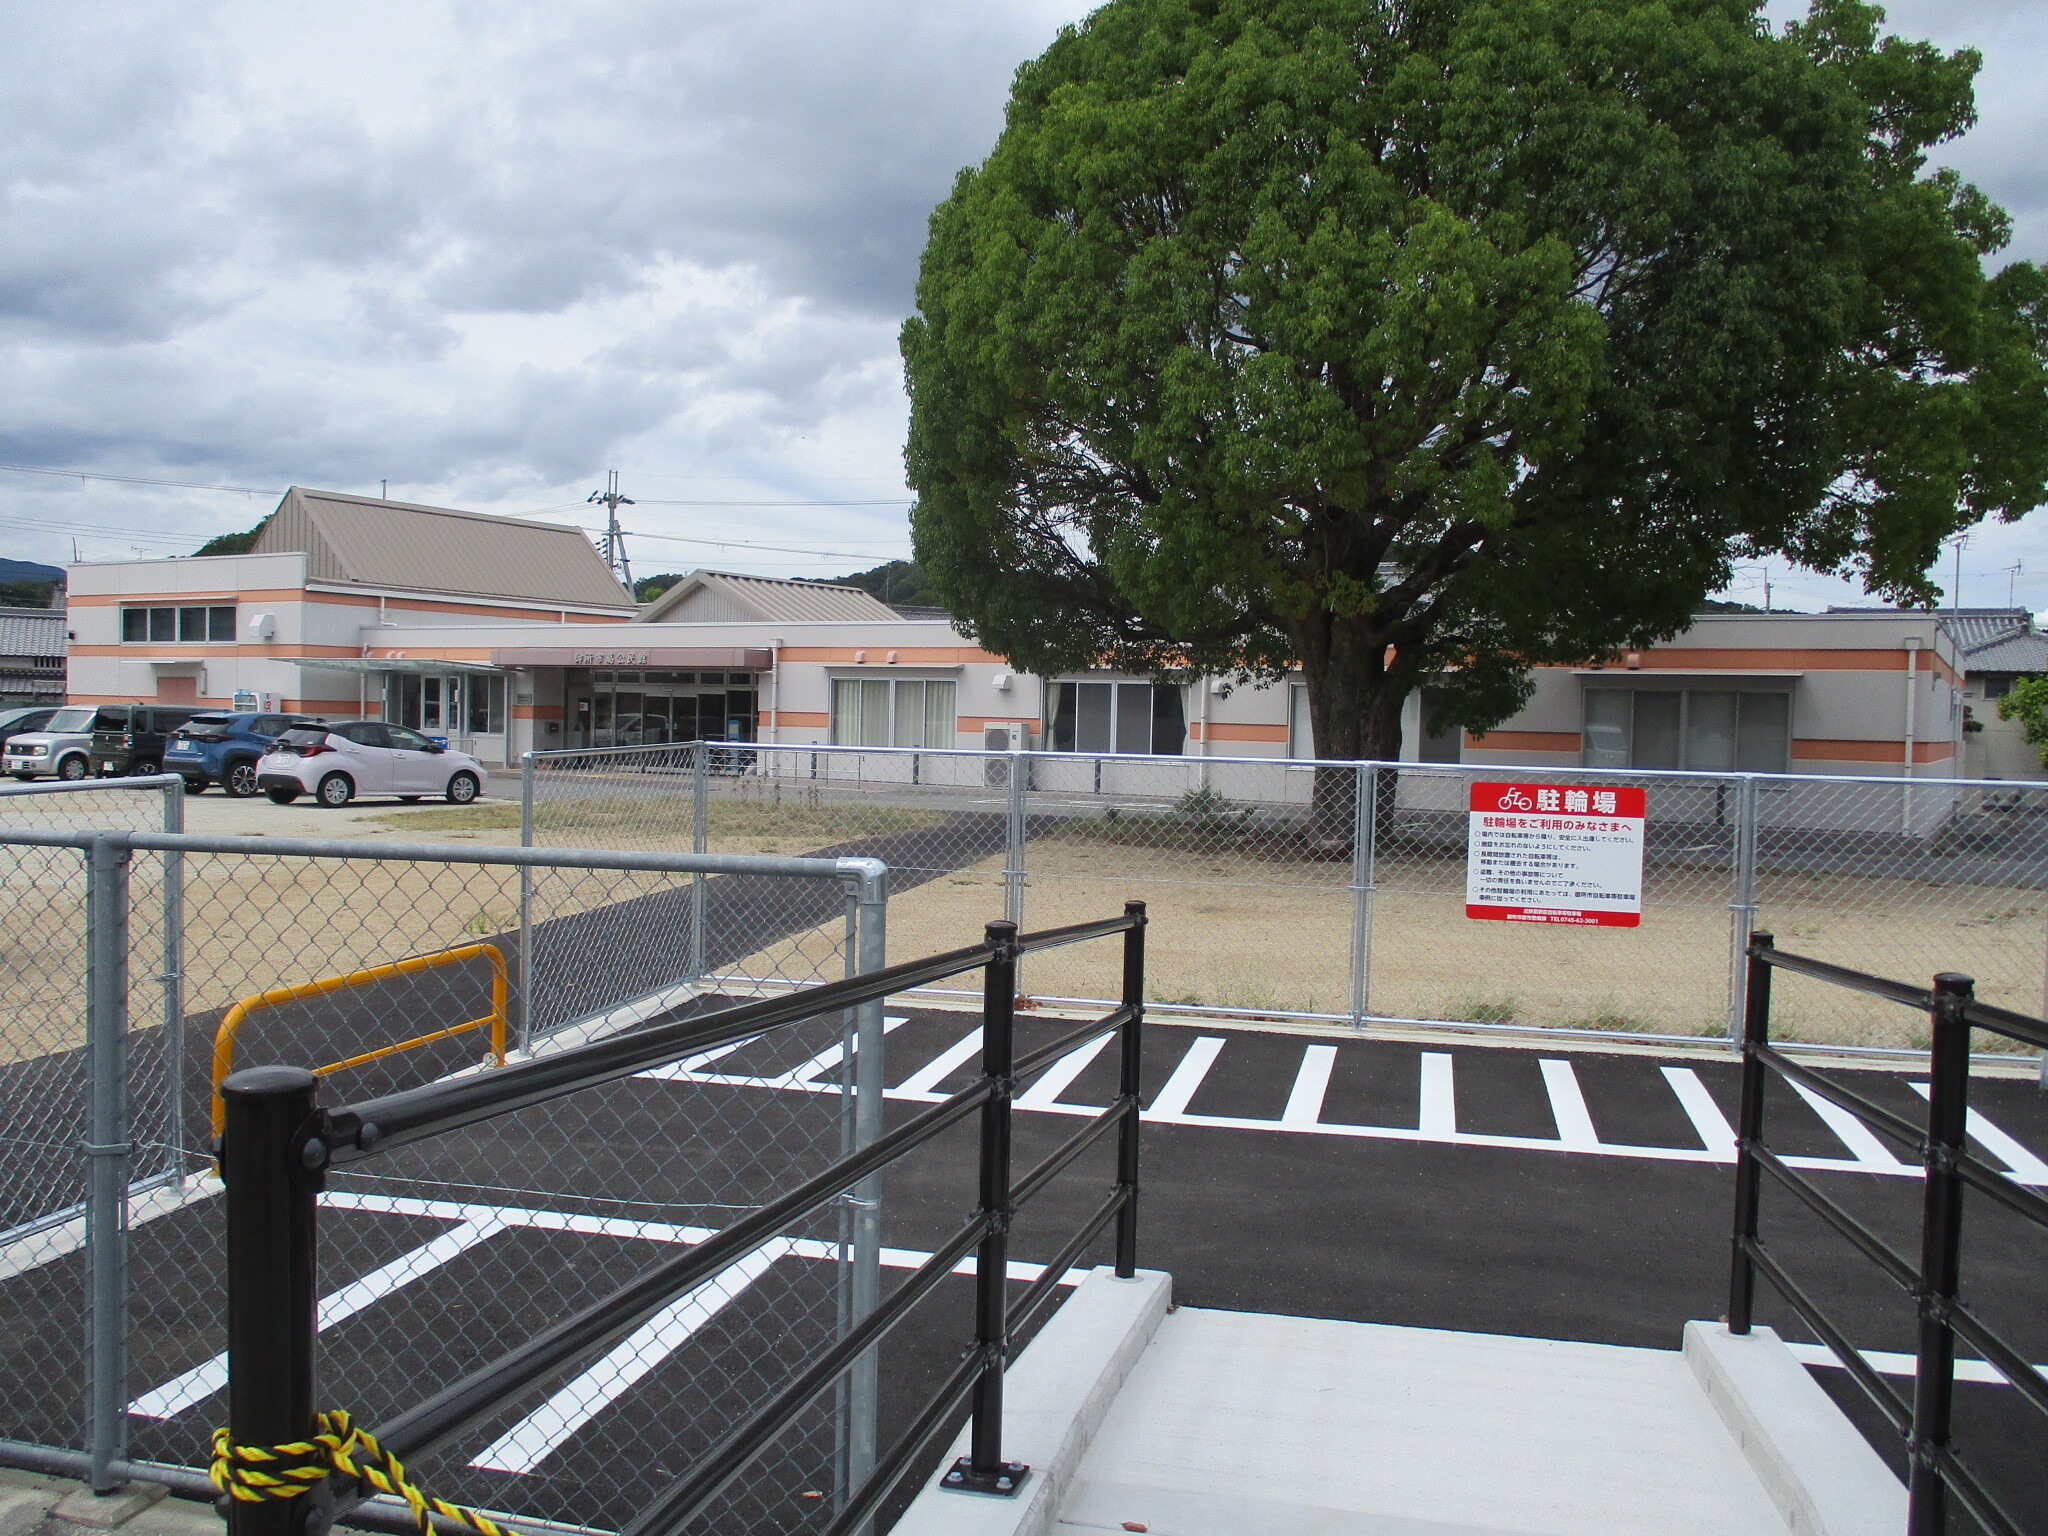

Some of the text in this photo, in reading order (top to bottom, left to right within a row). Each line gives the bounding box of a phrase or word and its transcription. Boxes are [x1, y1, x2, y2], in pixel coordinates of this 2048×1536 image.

[1536, 789, 1617, 813] 駐輪場
[1483, 816, 1632, 832] 駐輪場をご利用のみなさまへ
